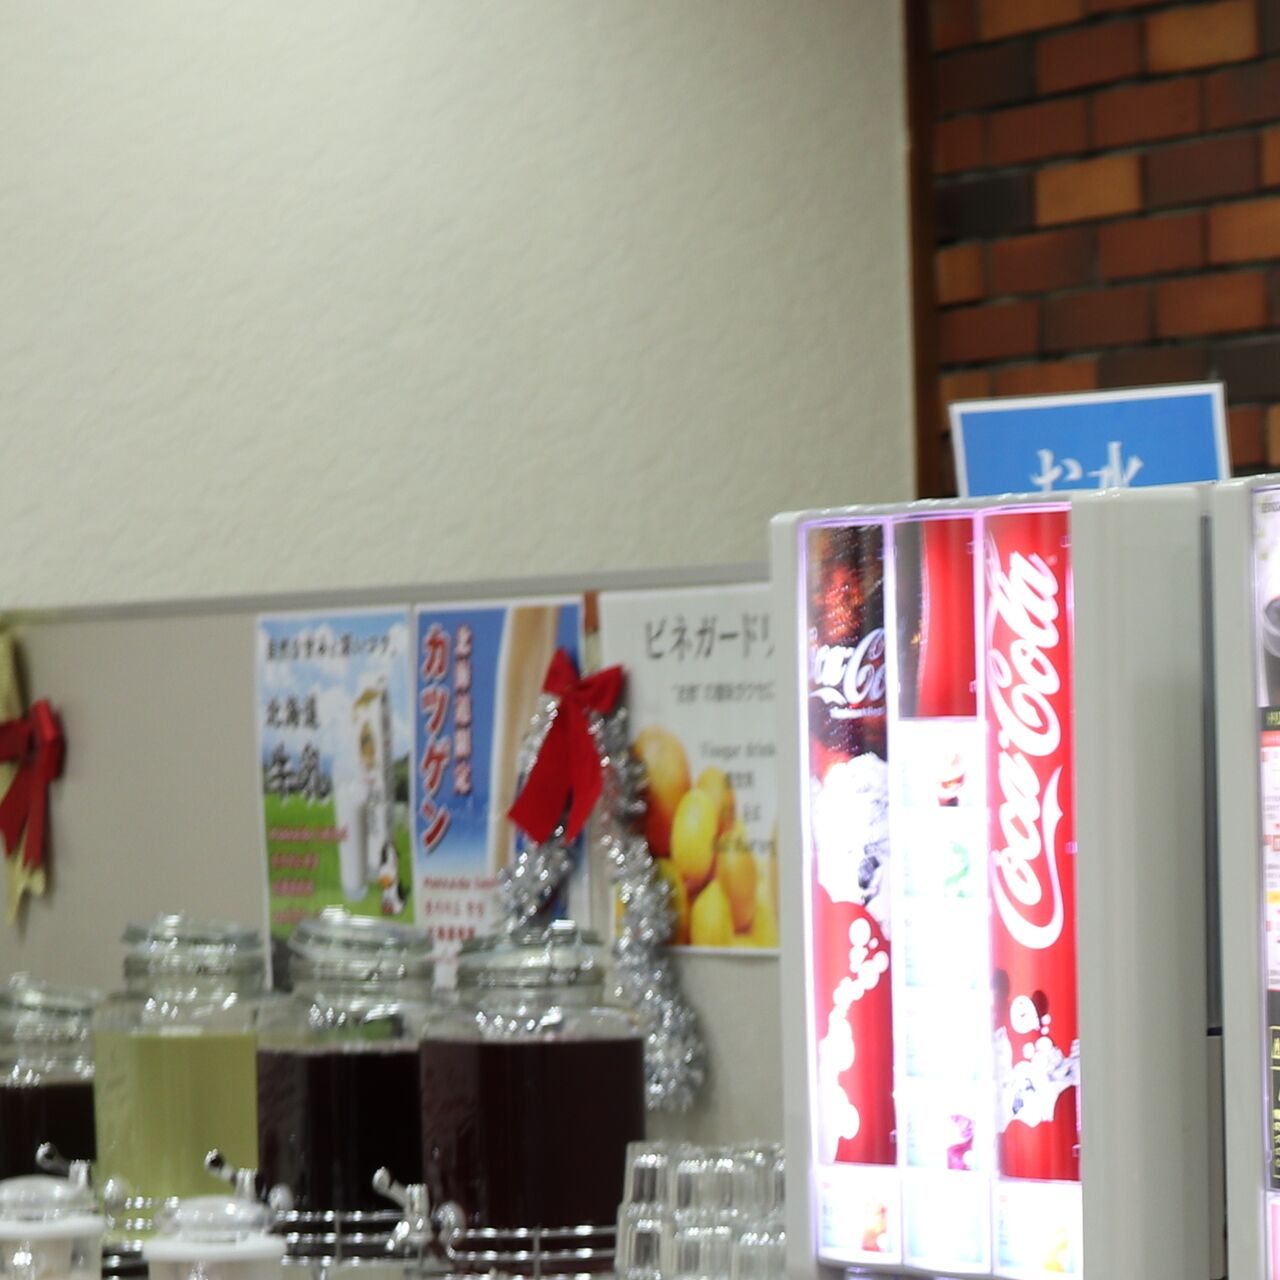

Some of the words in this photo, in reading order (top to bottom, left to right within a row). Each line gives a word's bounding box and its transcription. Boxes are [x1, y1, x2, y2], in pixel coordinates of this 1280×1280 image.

[420, 623, 450, 853] カツゲン
[986, 528, 1064, 950] Coca-Cola
